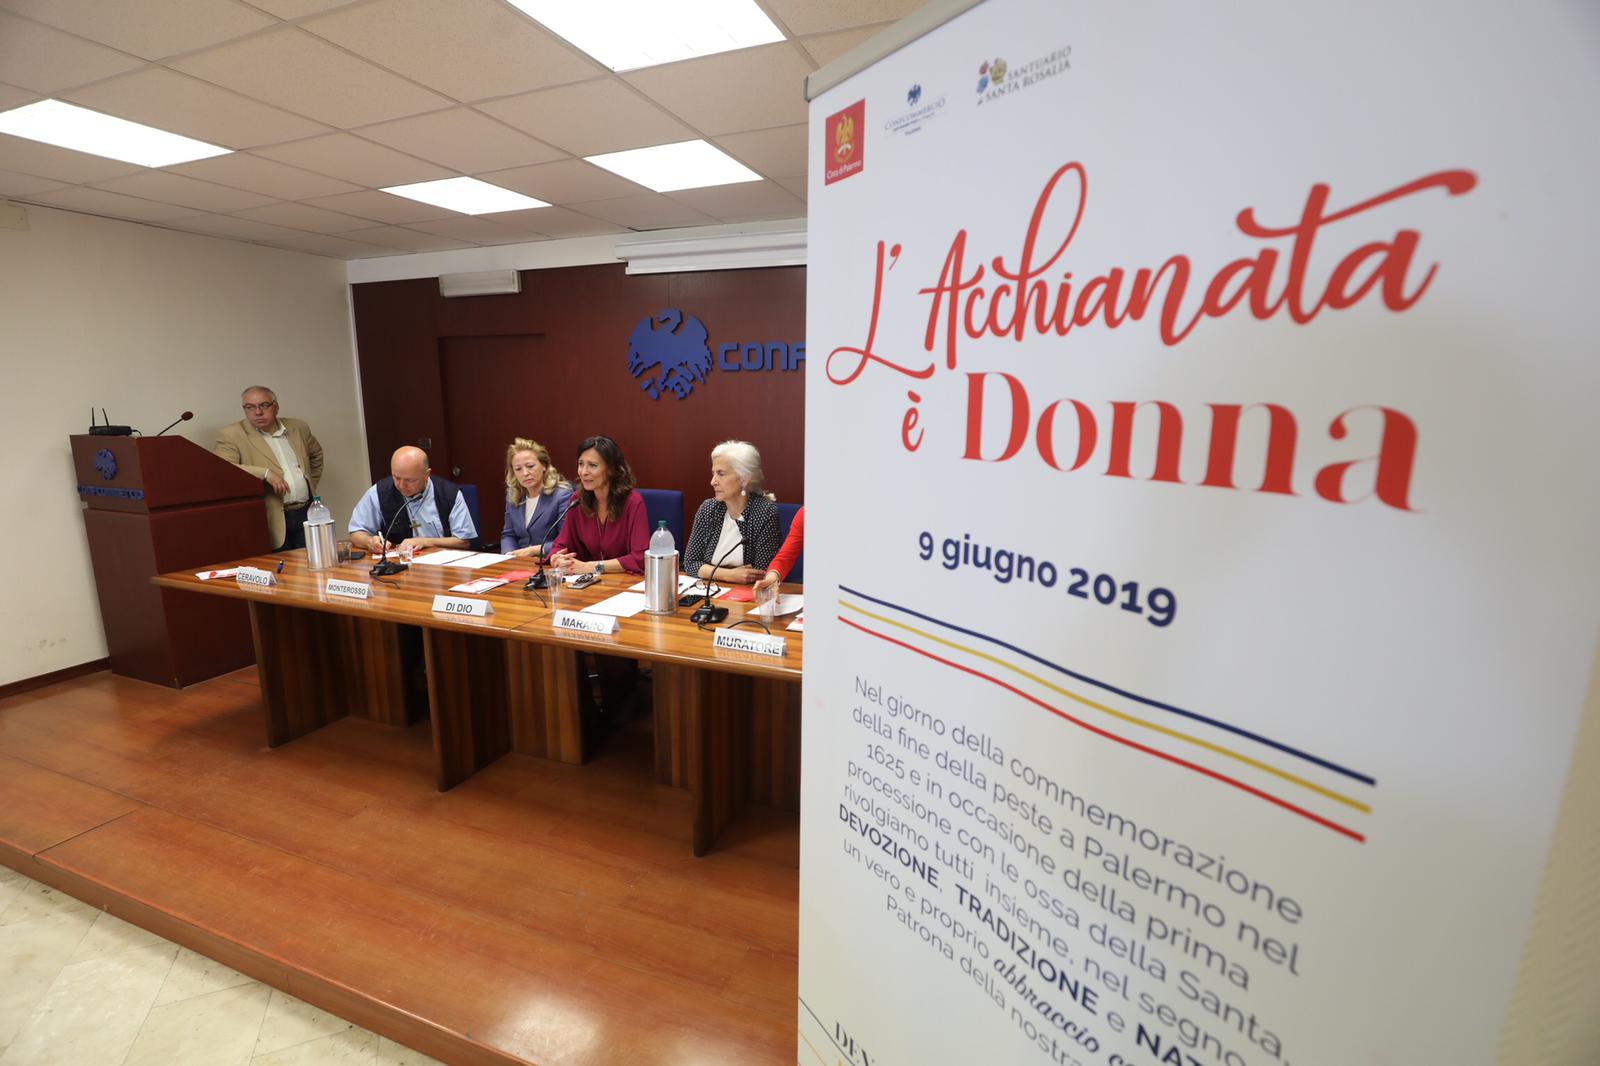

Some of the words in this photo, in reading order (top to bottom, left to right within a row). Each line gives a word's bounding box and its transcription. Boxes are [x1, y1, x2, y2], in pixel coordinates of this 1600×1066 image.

[901, 390, 925, 452] è
[960, 371, 1424, 514] Donna
[237, 572, 268, 585] CERAVOLO
[328, 584, 367, 595] MONTEROSSO
[445, 602, 455, 611] DI
[456, 603, 473, 613] DIO
[716, 635, 780, 655] MURATORE
[918, 531, 934, 561] 9
[941, 533, 1058, 589] giugno
[1067, 567, 1178, 628] 2019
[847, 760, 953, 836] processione
[957, 828, 996, 865] con
[1000, 852, 1020, 884] le
[1023, 878, 1080, 930] ossa
[1088, 922, 1167, 983] della
[852, 706, 893, 740] della
[898, 727, 931, 760] fine
[935, 750, 987, 792] della
[992, 782, 1053, 836] peste
[1059, 828, 1075, 851] a
[1083, 835, 1226, 928] Palermo
[1236, 920, 1300, 977] nel
[855, 675, 884, 706] Nel
[887, 695, 946, 737] giorno
[951, 725, 1005, 766] della
[1009, 757, 1303, 925] commemorazione
[866, 744, 905, 780] 1625
[909, 768, 922, 786] e
[926, 772, 943, 800] in
[948, 791, 1057, 875] occasione
[1063, 868, 1136, 925] della
[1146, 915, 1249, 991] prima
[843, 838, 861, 864] un
[864, 854, 901, 891] vero
[904, 885, 916, 903] e
[920, 897, 990, 960] proprio
[993, 958, 1100, 1054] abbraccio
[844, 783, 930, 852] rivolgiamo
[934, 840, 975, 881] tutti
[1084, 956, 1131, 1001] nel
[886, 894, 955, 961] Patrona
[960, 955, 1006, 1011] della
[954, 883, 1099, 1016] TRADIZIONE
[1106, 1010, 1126, 1034] e
